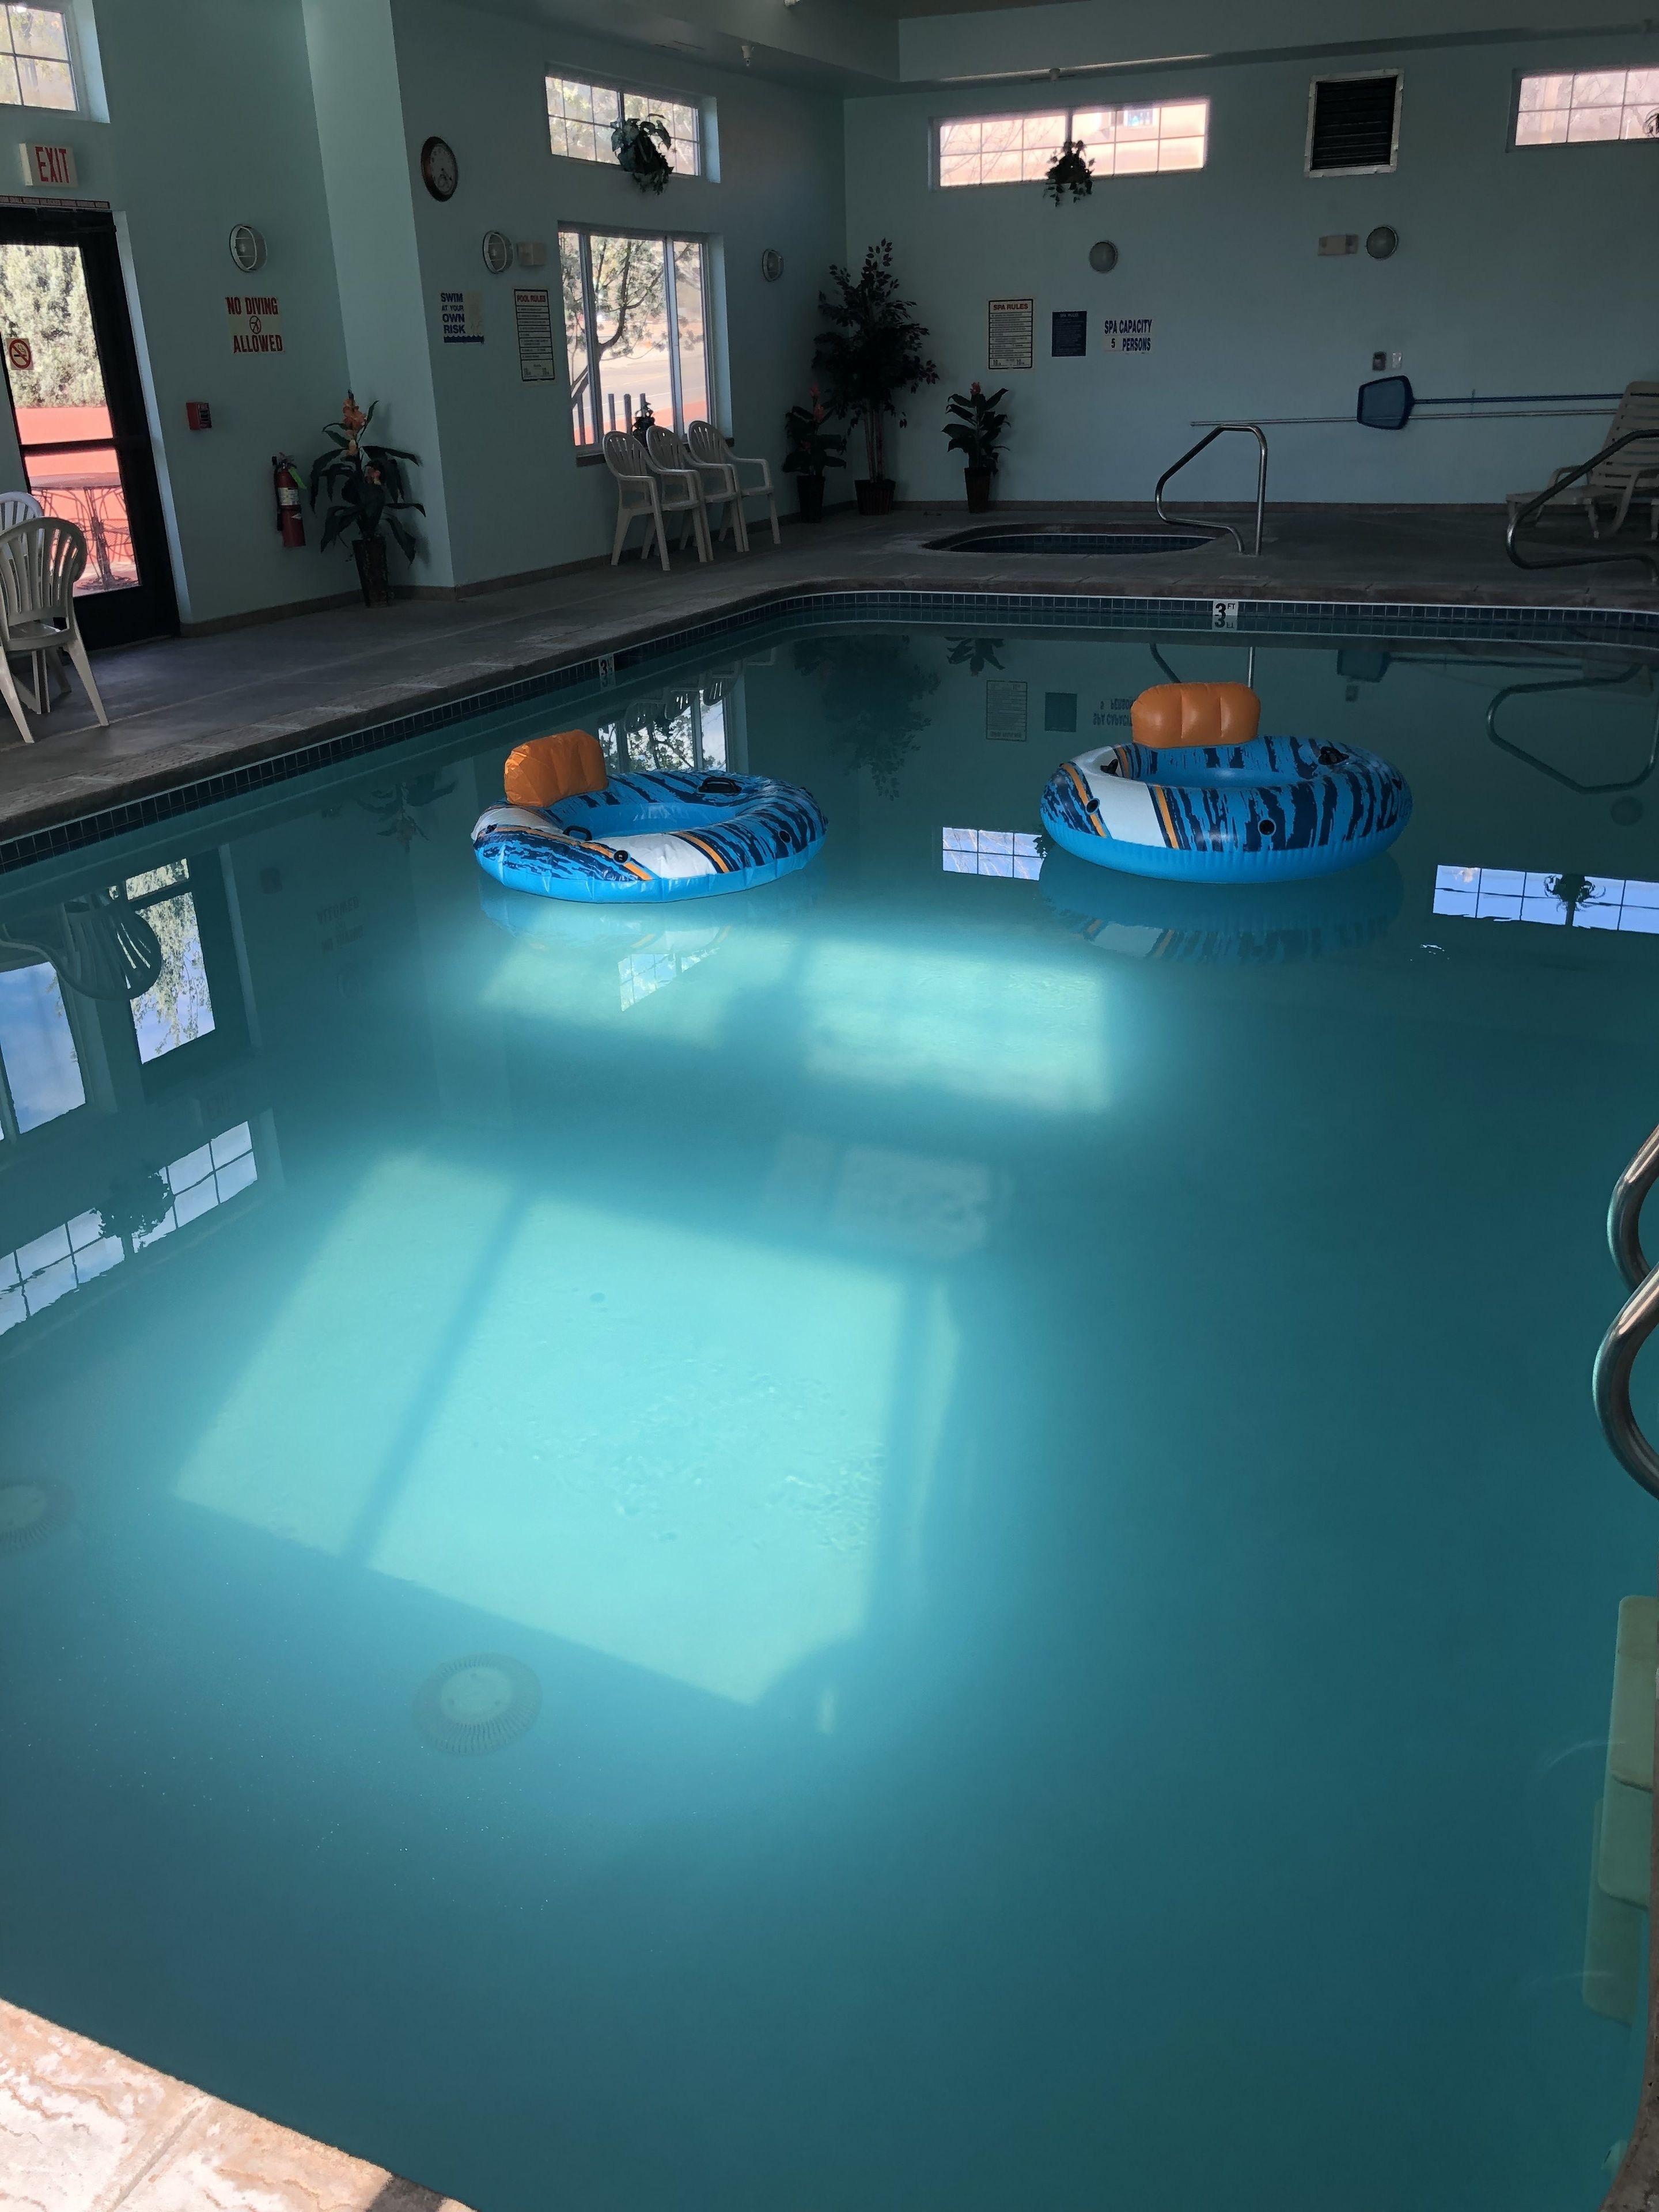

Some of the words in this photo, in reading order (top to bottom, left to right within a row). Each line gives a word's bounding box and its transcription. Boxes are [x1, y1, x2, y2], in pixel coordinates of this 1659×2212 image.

[35, 146, 69, 184] EXIT
[440, 293, 463, 302] SWIM
[226, 297, 242, 315] NO
[245, 297, 279, 315] DIVING
[442, 313, 465, 323] OWN
[443, 324, 465, 334] RISK
[1104, 320, 1118, 334] SPA
[1119, 319, 1152, 334] CAPACITY
[233, 335, 283, 353] ALLOWED
[1111, 338, 1116, 349] 5
[1122, 338, 1151, 351] PERSONS
[1214, 603, 1226, 616] 3
